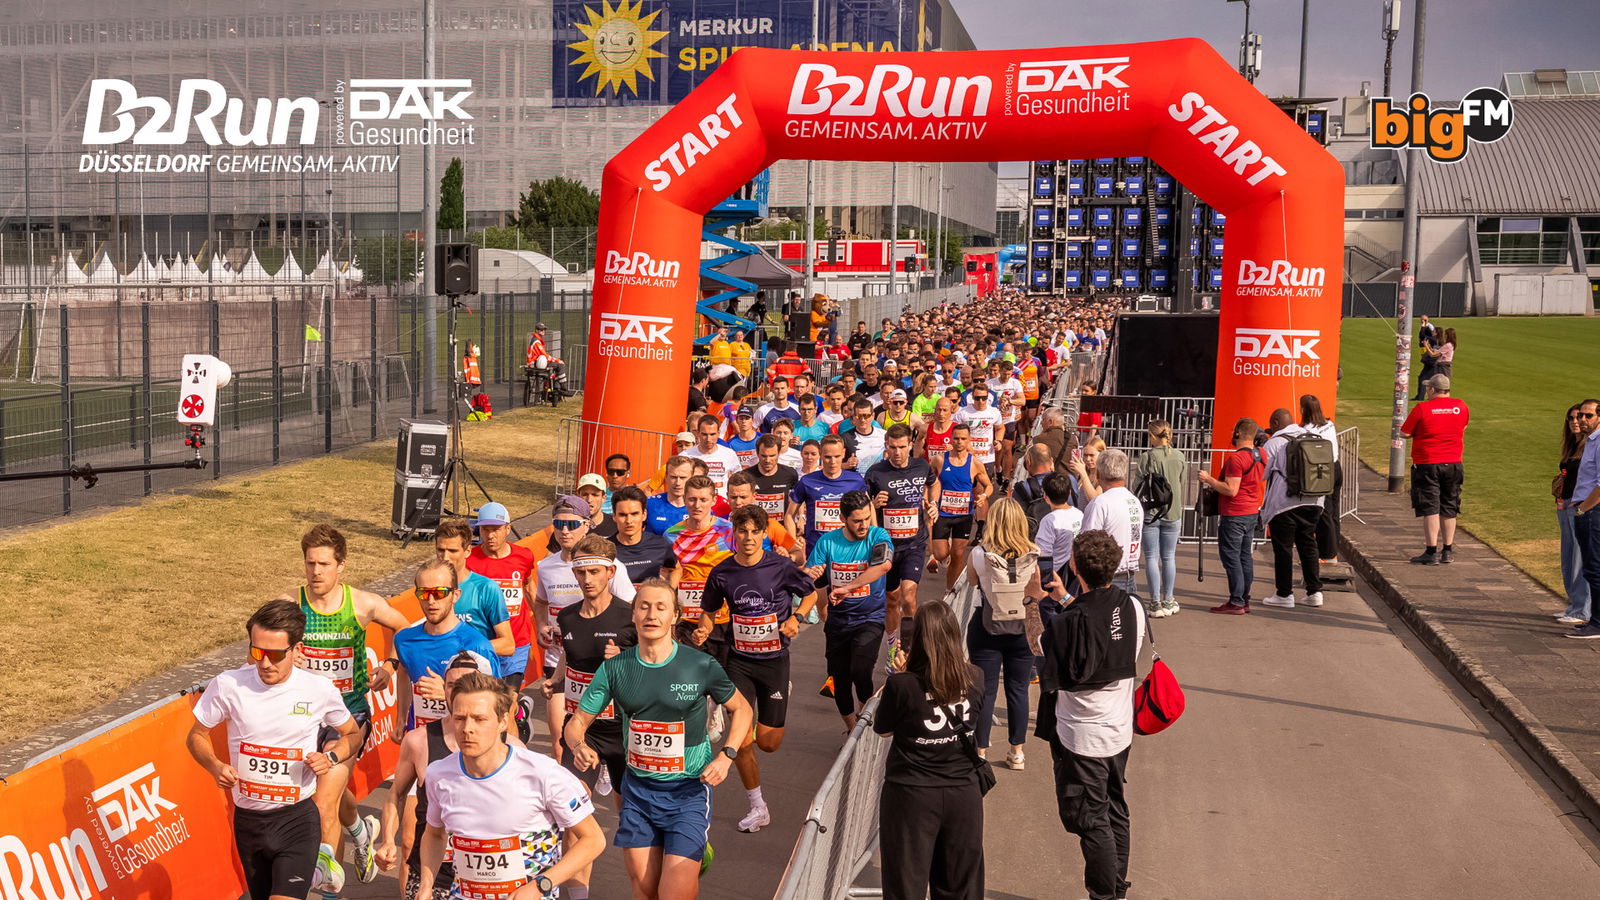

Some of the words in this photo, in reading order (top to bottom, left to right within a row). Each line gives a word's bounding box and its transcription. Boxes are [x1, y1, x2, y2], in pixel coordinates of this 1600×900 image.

[680, 17, 773, 37] MERKUR
[1003, 62, 1014, 77] by
[1018, 56, 1130, 92] DAK
[787, 62, 992, 119] B2Run
[1003, 78, 1014, 117] powered
[1016, 89, 1130, 116] Gesundheit
[644, 92, 744, 192] START
[1168, 92, 1287, 187] START
[604, 250, 680, 279] B2Run
[1237, 259, 1326, 287] B2Run
[599, 312, 673, 345] DAK
[598, 339, 673, 361] Gesundheit
[1234, 327, 1321, 360] DAK
[1233, 357, 1321, 378] Gesundheit
[888, 479, 912, 489] GEA
[896, 486, 919, 496] GEA
[890, 516, 912, 524] 8317
[738, 625, 773, 635] 12754
[1110, 606, 1123, 641] #Vans
[302, 632, 352, 641] PROVINZIAL
[306, 659, 349, 671] 11950
[670, 683, 699, 692] SPORT
[634, 733, 673, 748] 3879
[248, 757, 290, 776] 9391
[91, 761, 179, 843] DAK
[83, 796, 93, 815] by
[91, 818, 125, 880] powered
[114, 812, 191, 875] Gesundheit
[464, 854, 509, 870] 1794
